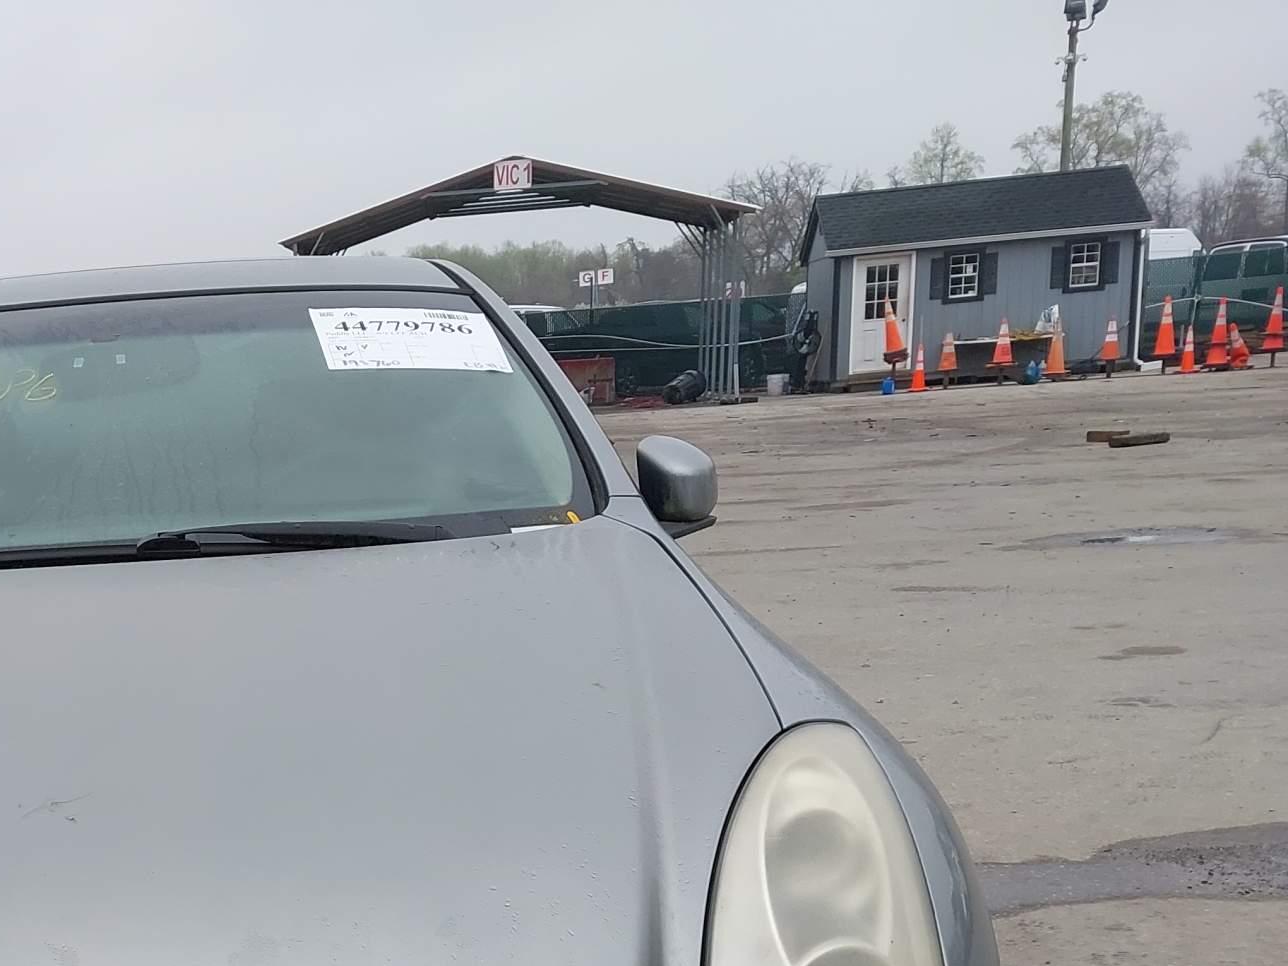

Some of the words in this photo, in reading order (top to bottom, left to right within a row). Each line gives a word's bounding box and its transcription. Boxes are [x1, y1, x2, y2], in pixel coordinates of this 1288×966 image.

[495, 164, 520, 186] VIC
[523, 162, 532, 184] 1
[582, 272, 593, 284] G
[601, 271, 609, 281] F
[334, 320, 474, 335] 44779786
